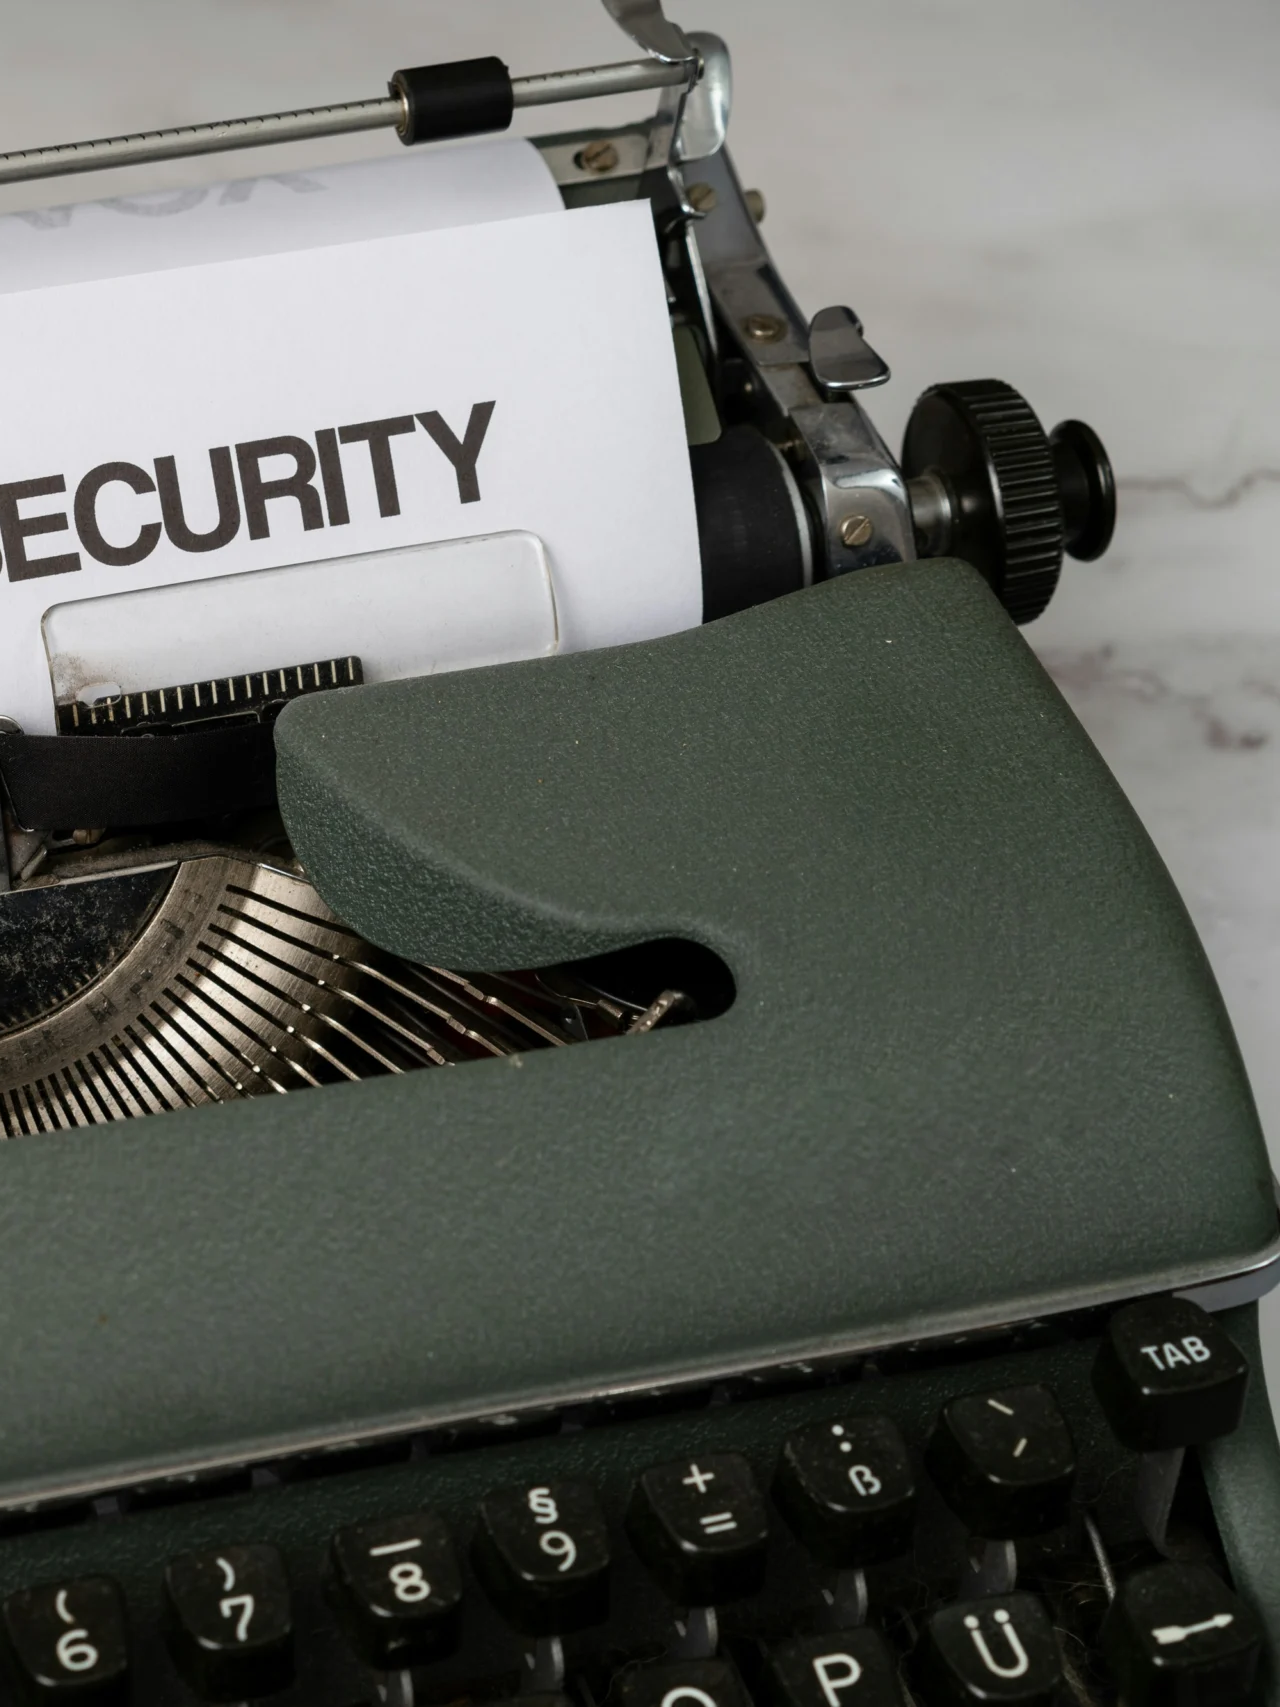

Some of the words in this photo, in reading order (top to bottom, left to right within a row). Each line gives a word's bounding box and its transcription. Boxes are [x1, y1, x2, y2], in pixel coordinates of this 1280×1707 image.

[1140, 1335, 1211, 1371] TAB
[539, 1529, 577, 1572] 9
[388, 1562, 431, 1602] 8
[219, 1594, 254, 1642] 7
[56, 1628, 99, 1672] 6
[963, 1608, 1030, 1679] Ü
[812, 1652, 862, 1707] P
